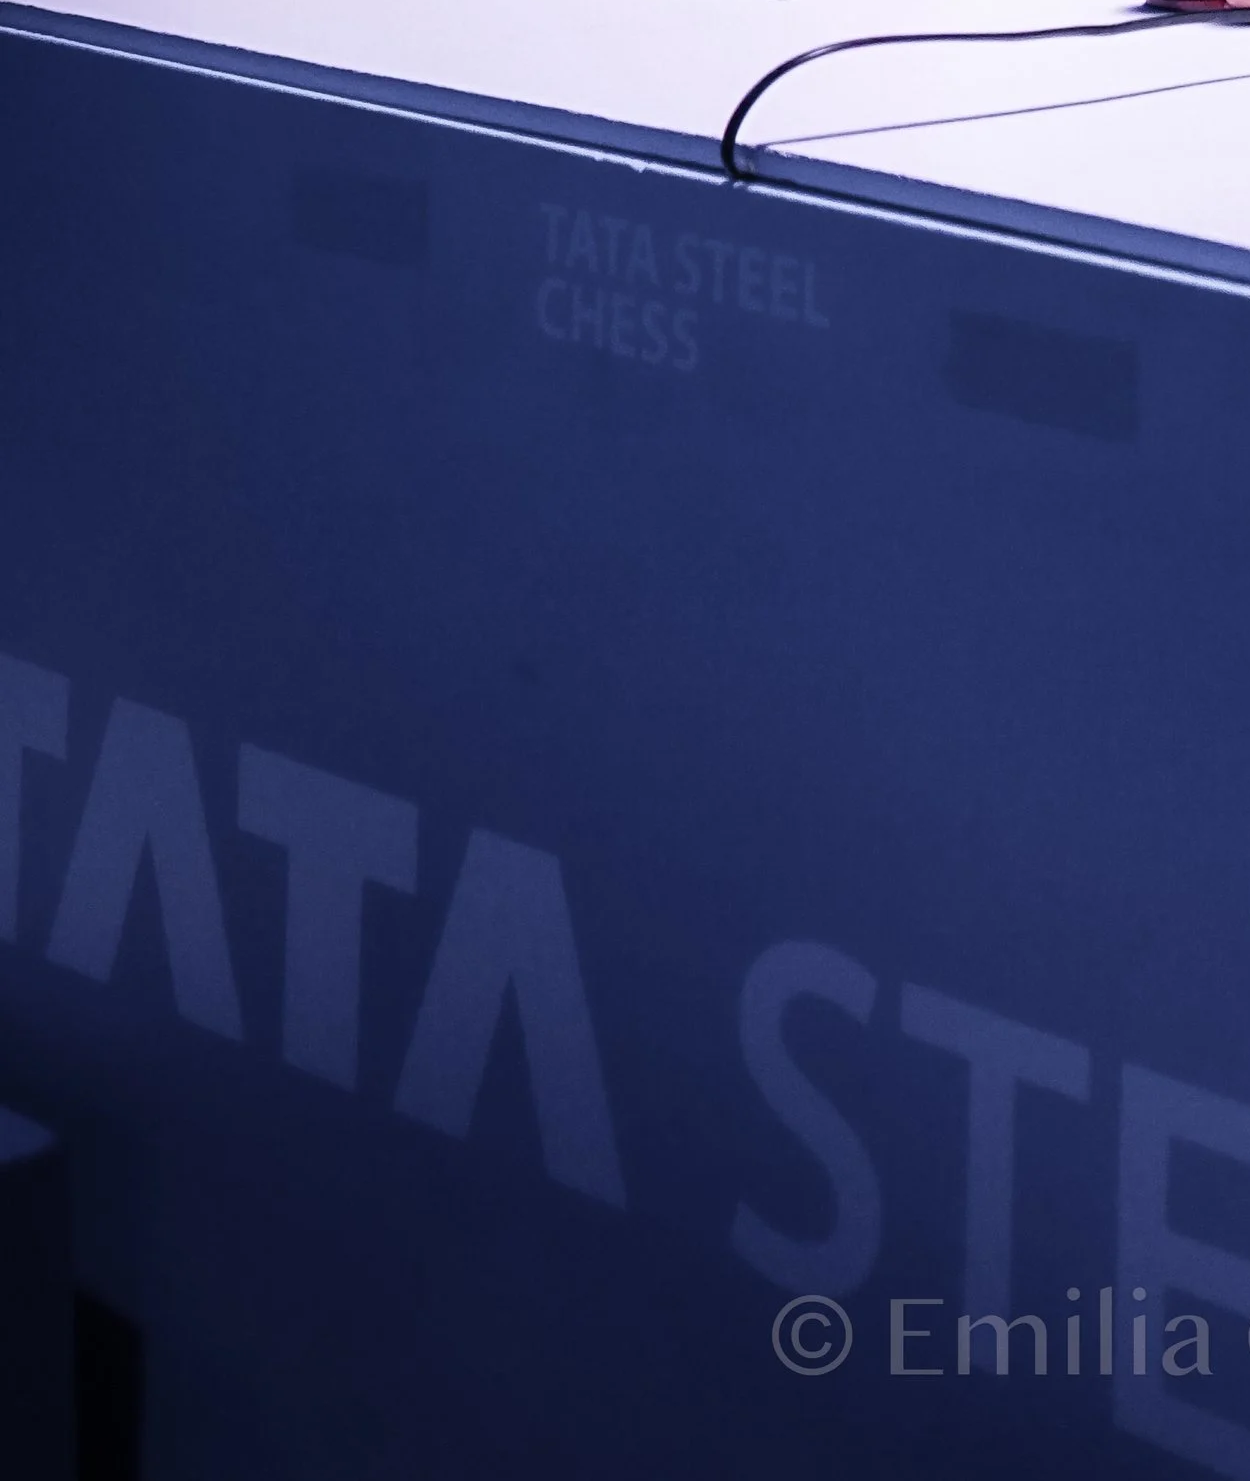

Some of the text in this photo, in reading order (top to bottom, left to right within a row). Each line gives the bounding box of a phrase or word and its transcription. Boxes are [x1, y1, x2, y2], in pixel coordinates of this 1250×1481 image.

[539, 201, 831, 329] TATA STEEL
[535, 275, 699, 373] CHESS
